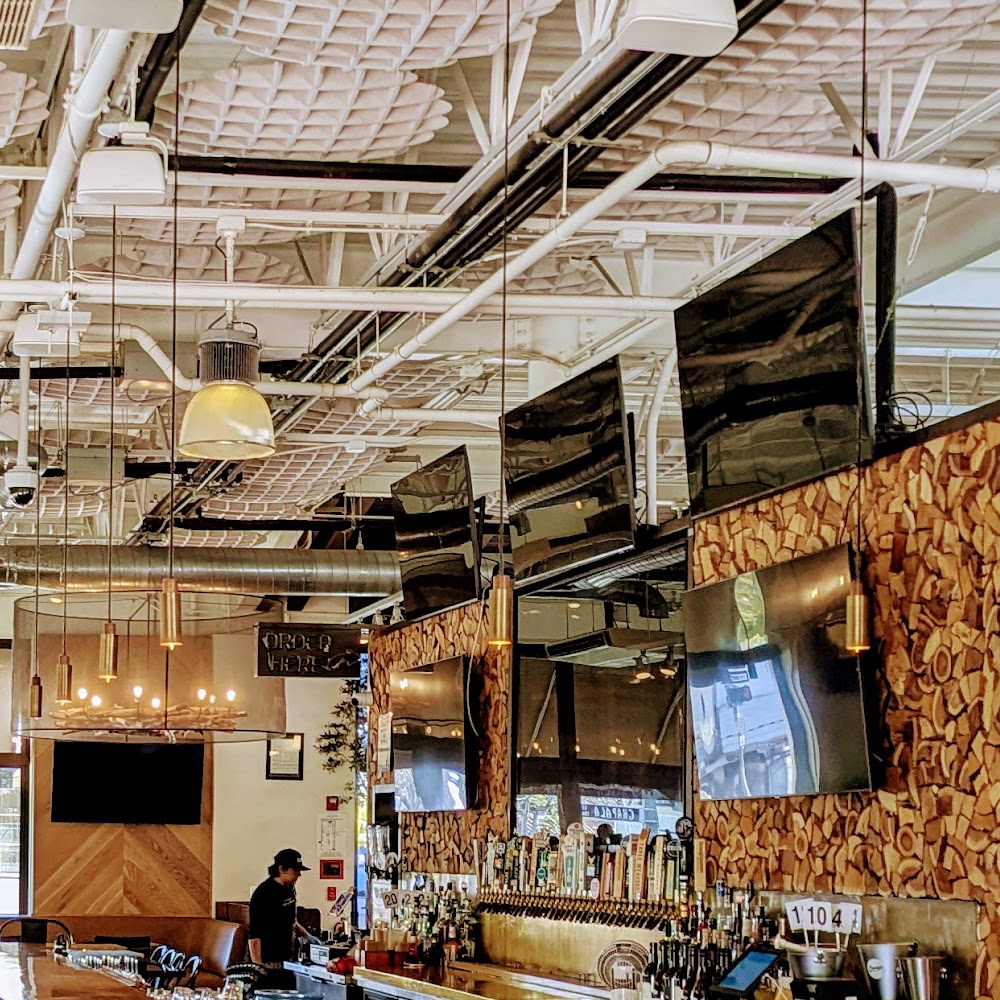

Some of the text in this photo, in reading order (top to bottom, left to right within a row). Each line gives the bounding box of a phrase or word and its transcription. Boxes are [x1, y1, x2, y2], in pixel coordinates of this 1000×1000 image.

[262, 633, 331, 652] ORDER
[267, 652, 321, 673] HERE
[385, 893, 398, 906] 20
[808, 906, 826, 925] 10
